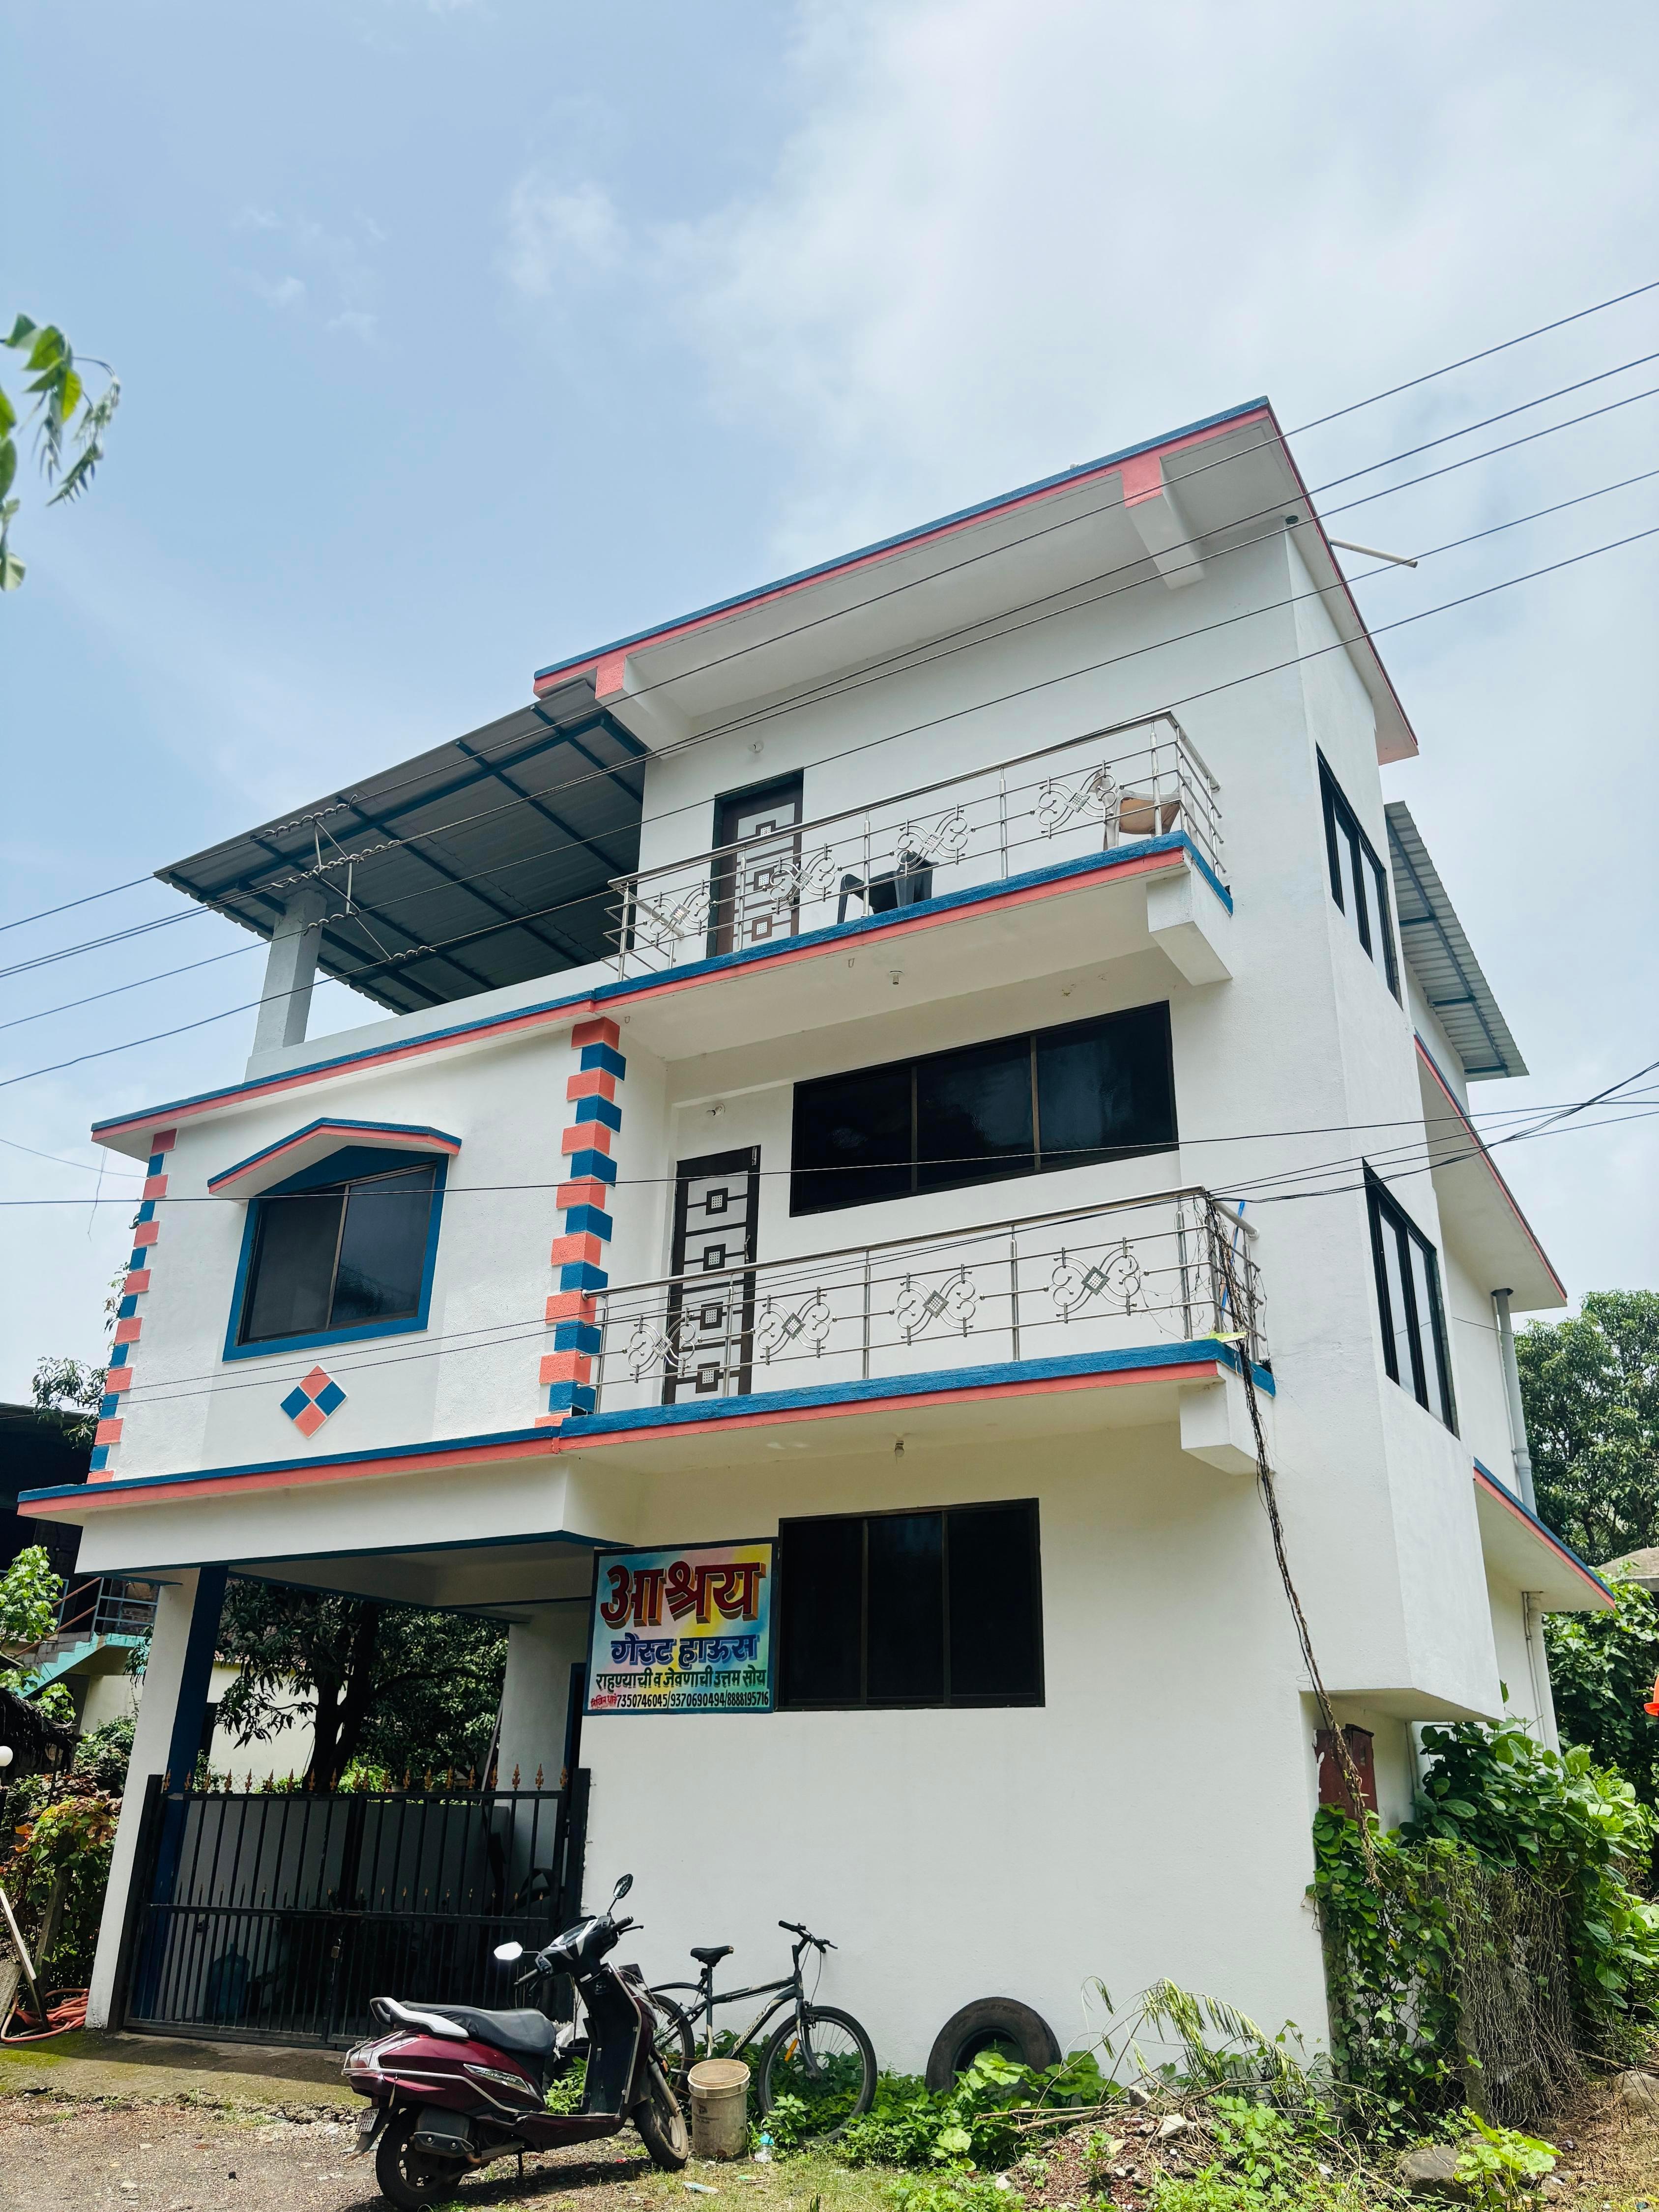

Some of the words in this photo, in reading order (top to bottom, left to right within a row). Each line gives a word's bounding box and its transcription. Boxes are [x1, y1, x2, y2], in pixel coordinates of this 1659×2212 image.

[600, 1561, 766, 1630] आश्रय
[611, 1632, 676, 1665] गेस्ट
[678, 1634, 760, 1670] हाऊस
[596, 1667, 653, 1694] राहण्याची
[654, 1672, 663, 1688] व
[663, 1665, 712, 1688] जेवणाची
[714, 1670, 741, 1688] उत्तम
[742, 1664, 766, 1687] सोय
